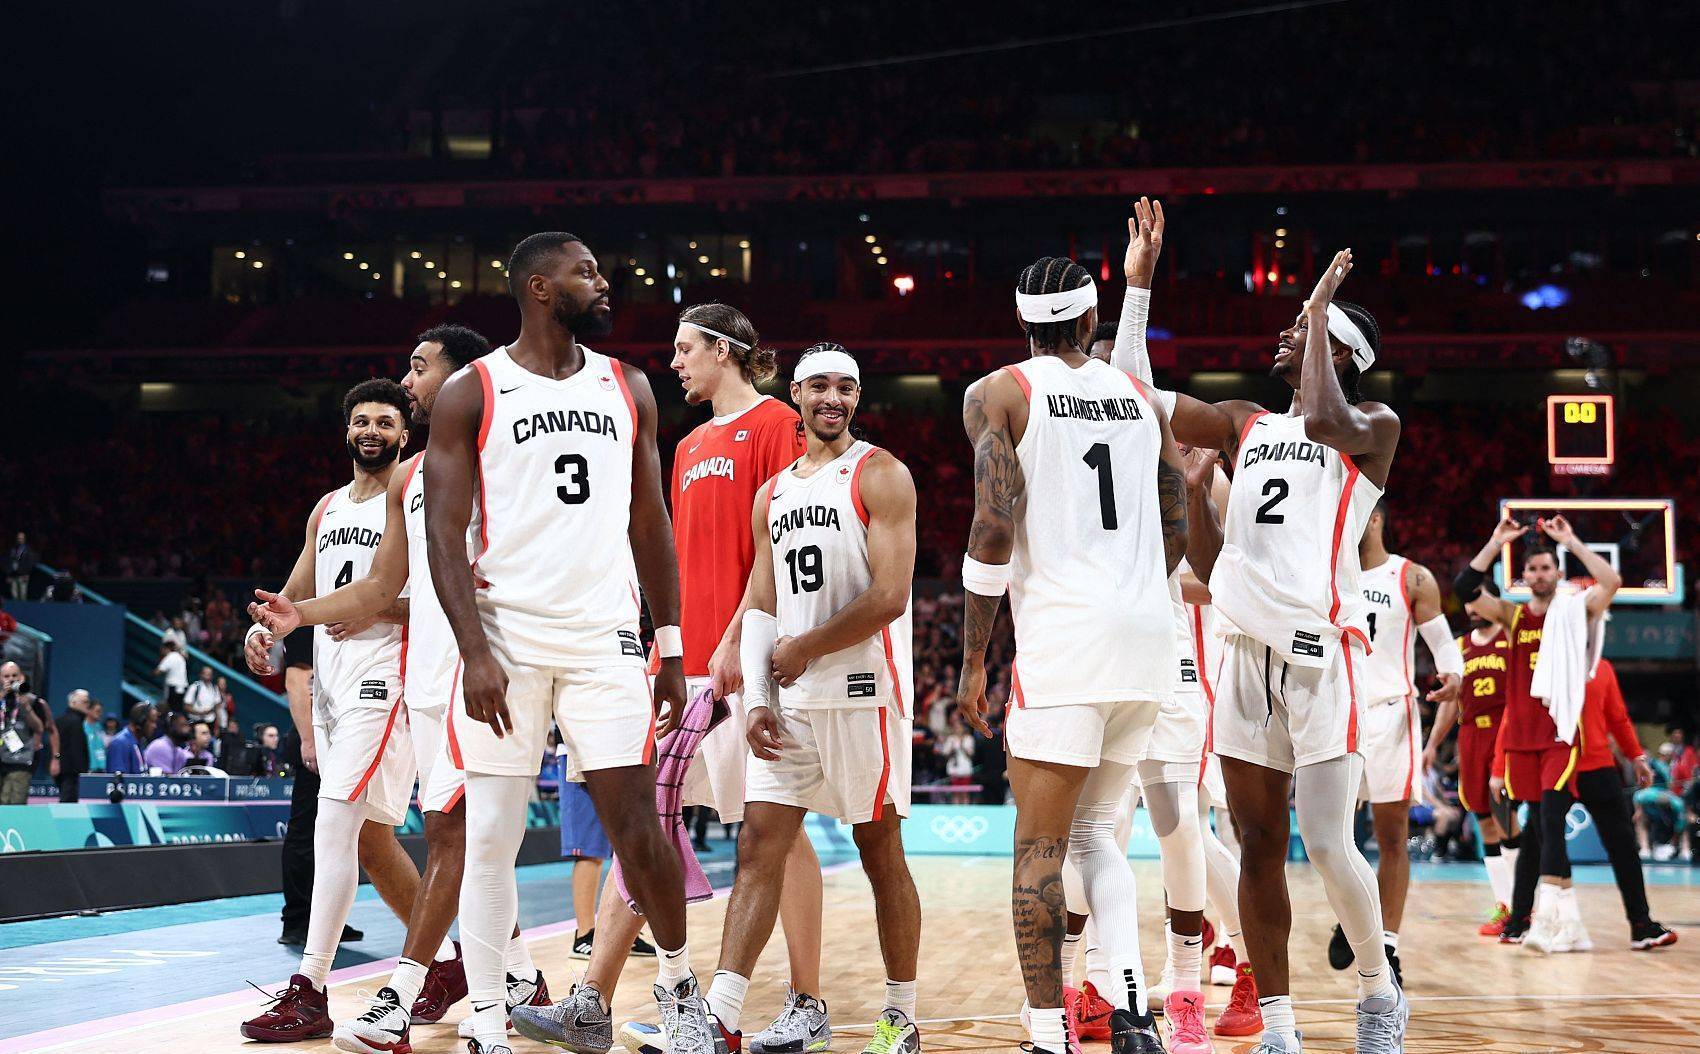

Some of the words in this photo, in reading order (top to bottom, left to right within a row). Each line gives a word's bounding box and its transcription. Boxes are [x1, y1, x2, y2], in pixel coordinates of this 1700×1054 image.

[1047, 394, 1143, 421] ALEXANDER-WALKER
[513, 410, 618, 444] CANADA
[1244, 442, 1325, 469] CANADA
[554, 453, 591, 505] 3
[682, 456, 734, 493] CANADA
[1082, 442, 1118, 531] 1
[1255, 478, 1290, 525] 2
[319, 527, 383, 554] CANADA
[770, 505, 841, 546] CANADA
[335, 560, 353, 590] 4
[784, 544, 824, 595] 19
[1473, 677, 1495, 697] 23
[158, 783, 202, 797] 2024
